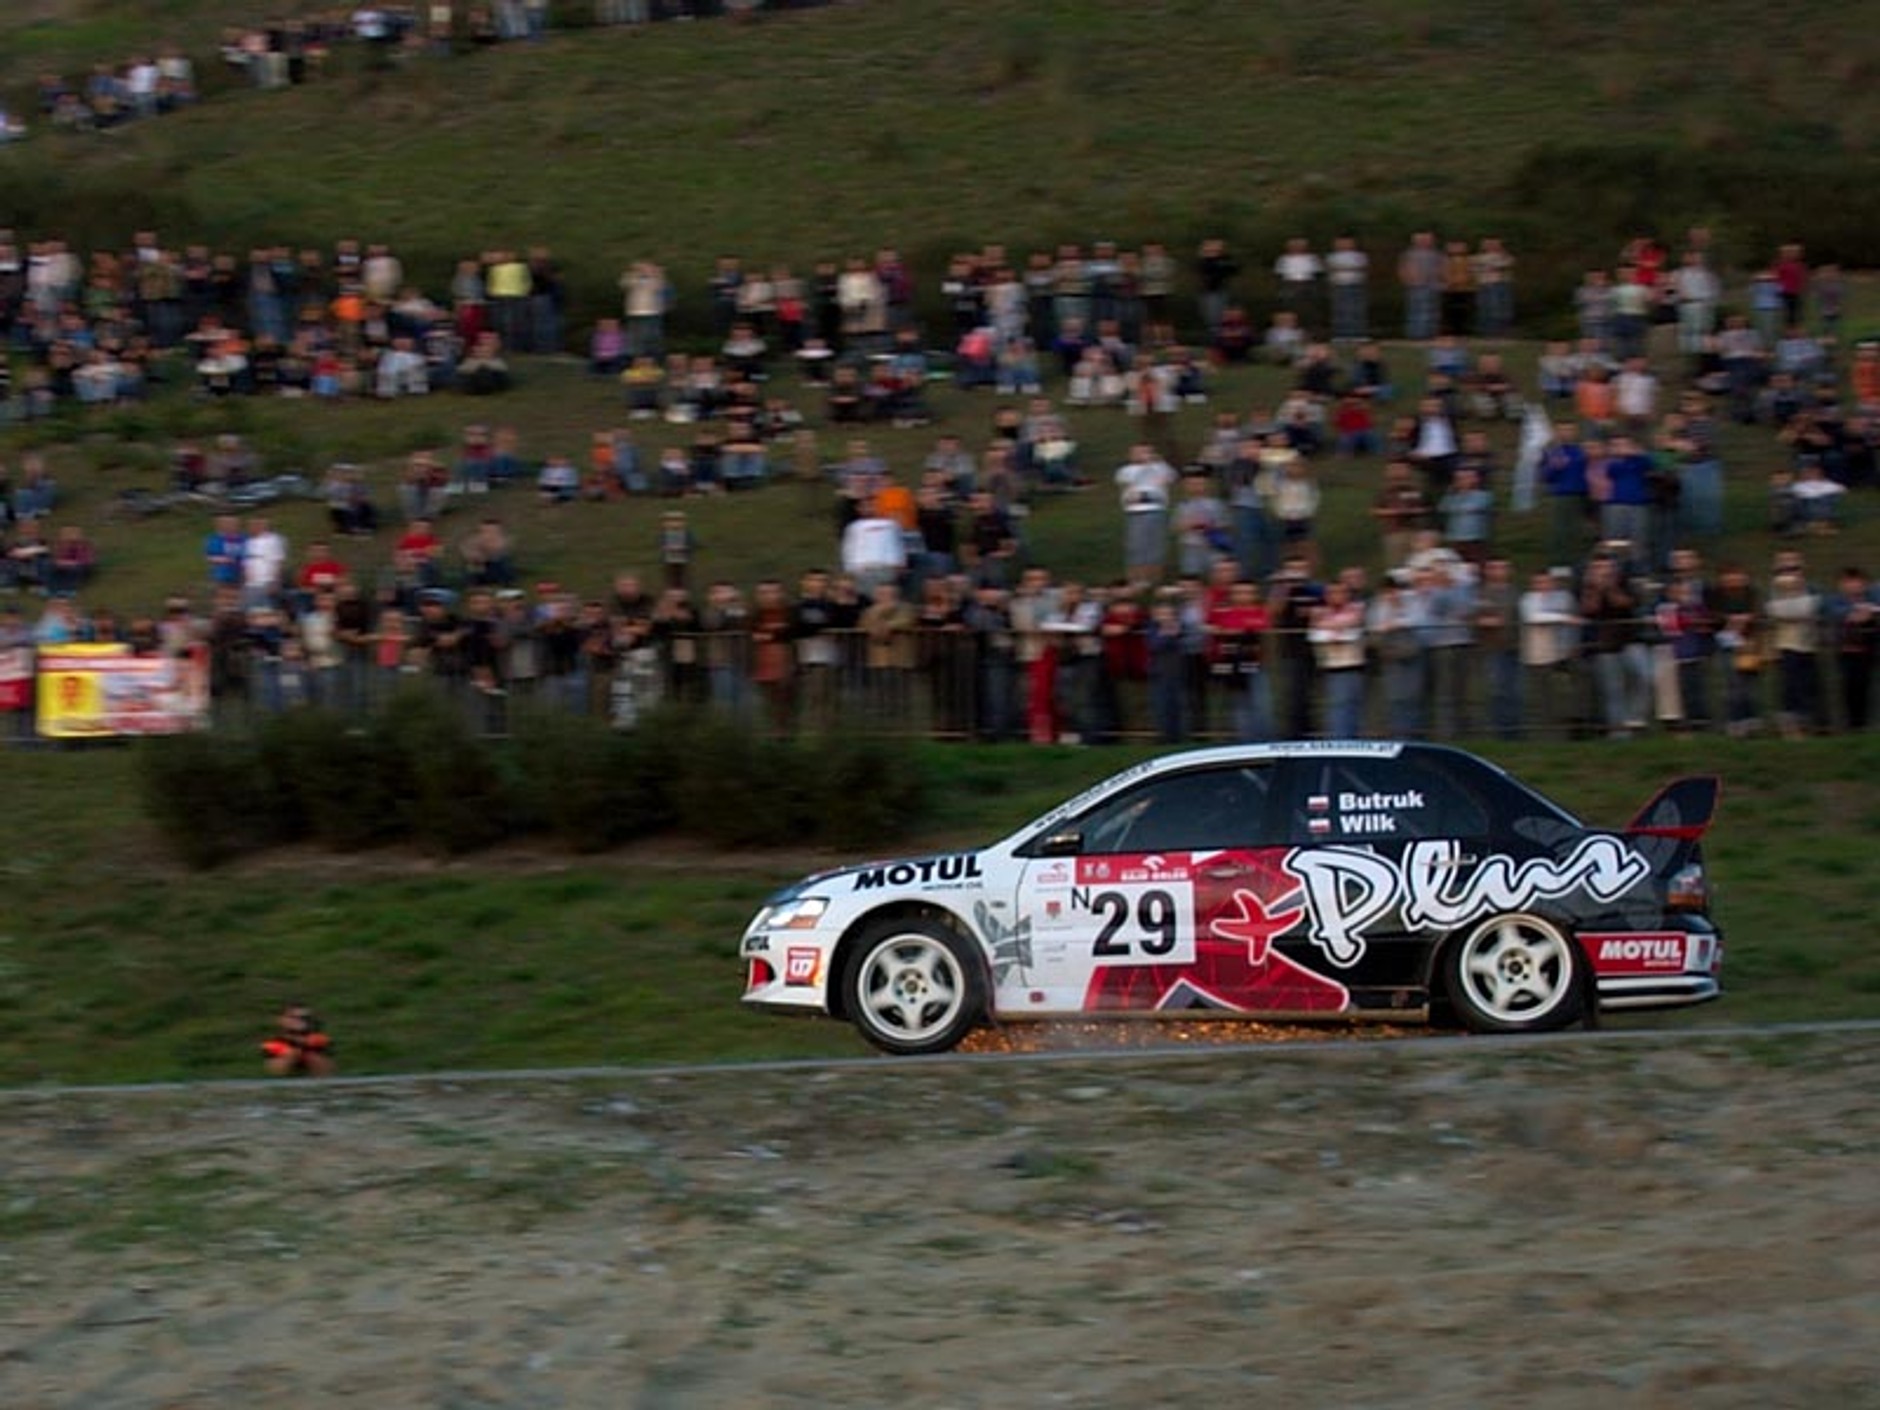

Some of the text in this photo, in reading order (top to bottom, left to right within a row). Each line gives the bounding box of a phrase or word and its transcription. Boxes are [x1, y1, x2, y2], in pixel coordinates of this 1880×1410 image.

[1339, 790, 1424, 811] Butruk
[1340, 813, 1396, 833] Wilk
[852, 855, 982, 891] MOTUL
[1071, 887, 1089, 909] N
[1091, 889, 1176, 957] 29
[1599, 940, 1682, 960] MOTUL
